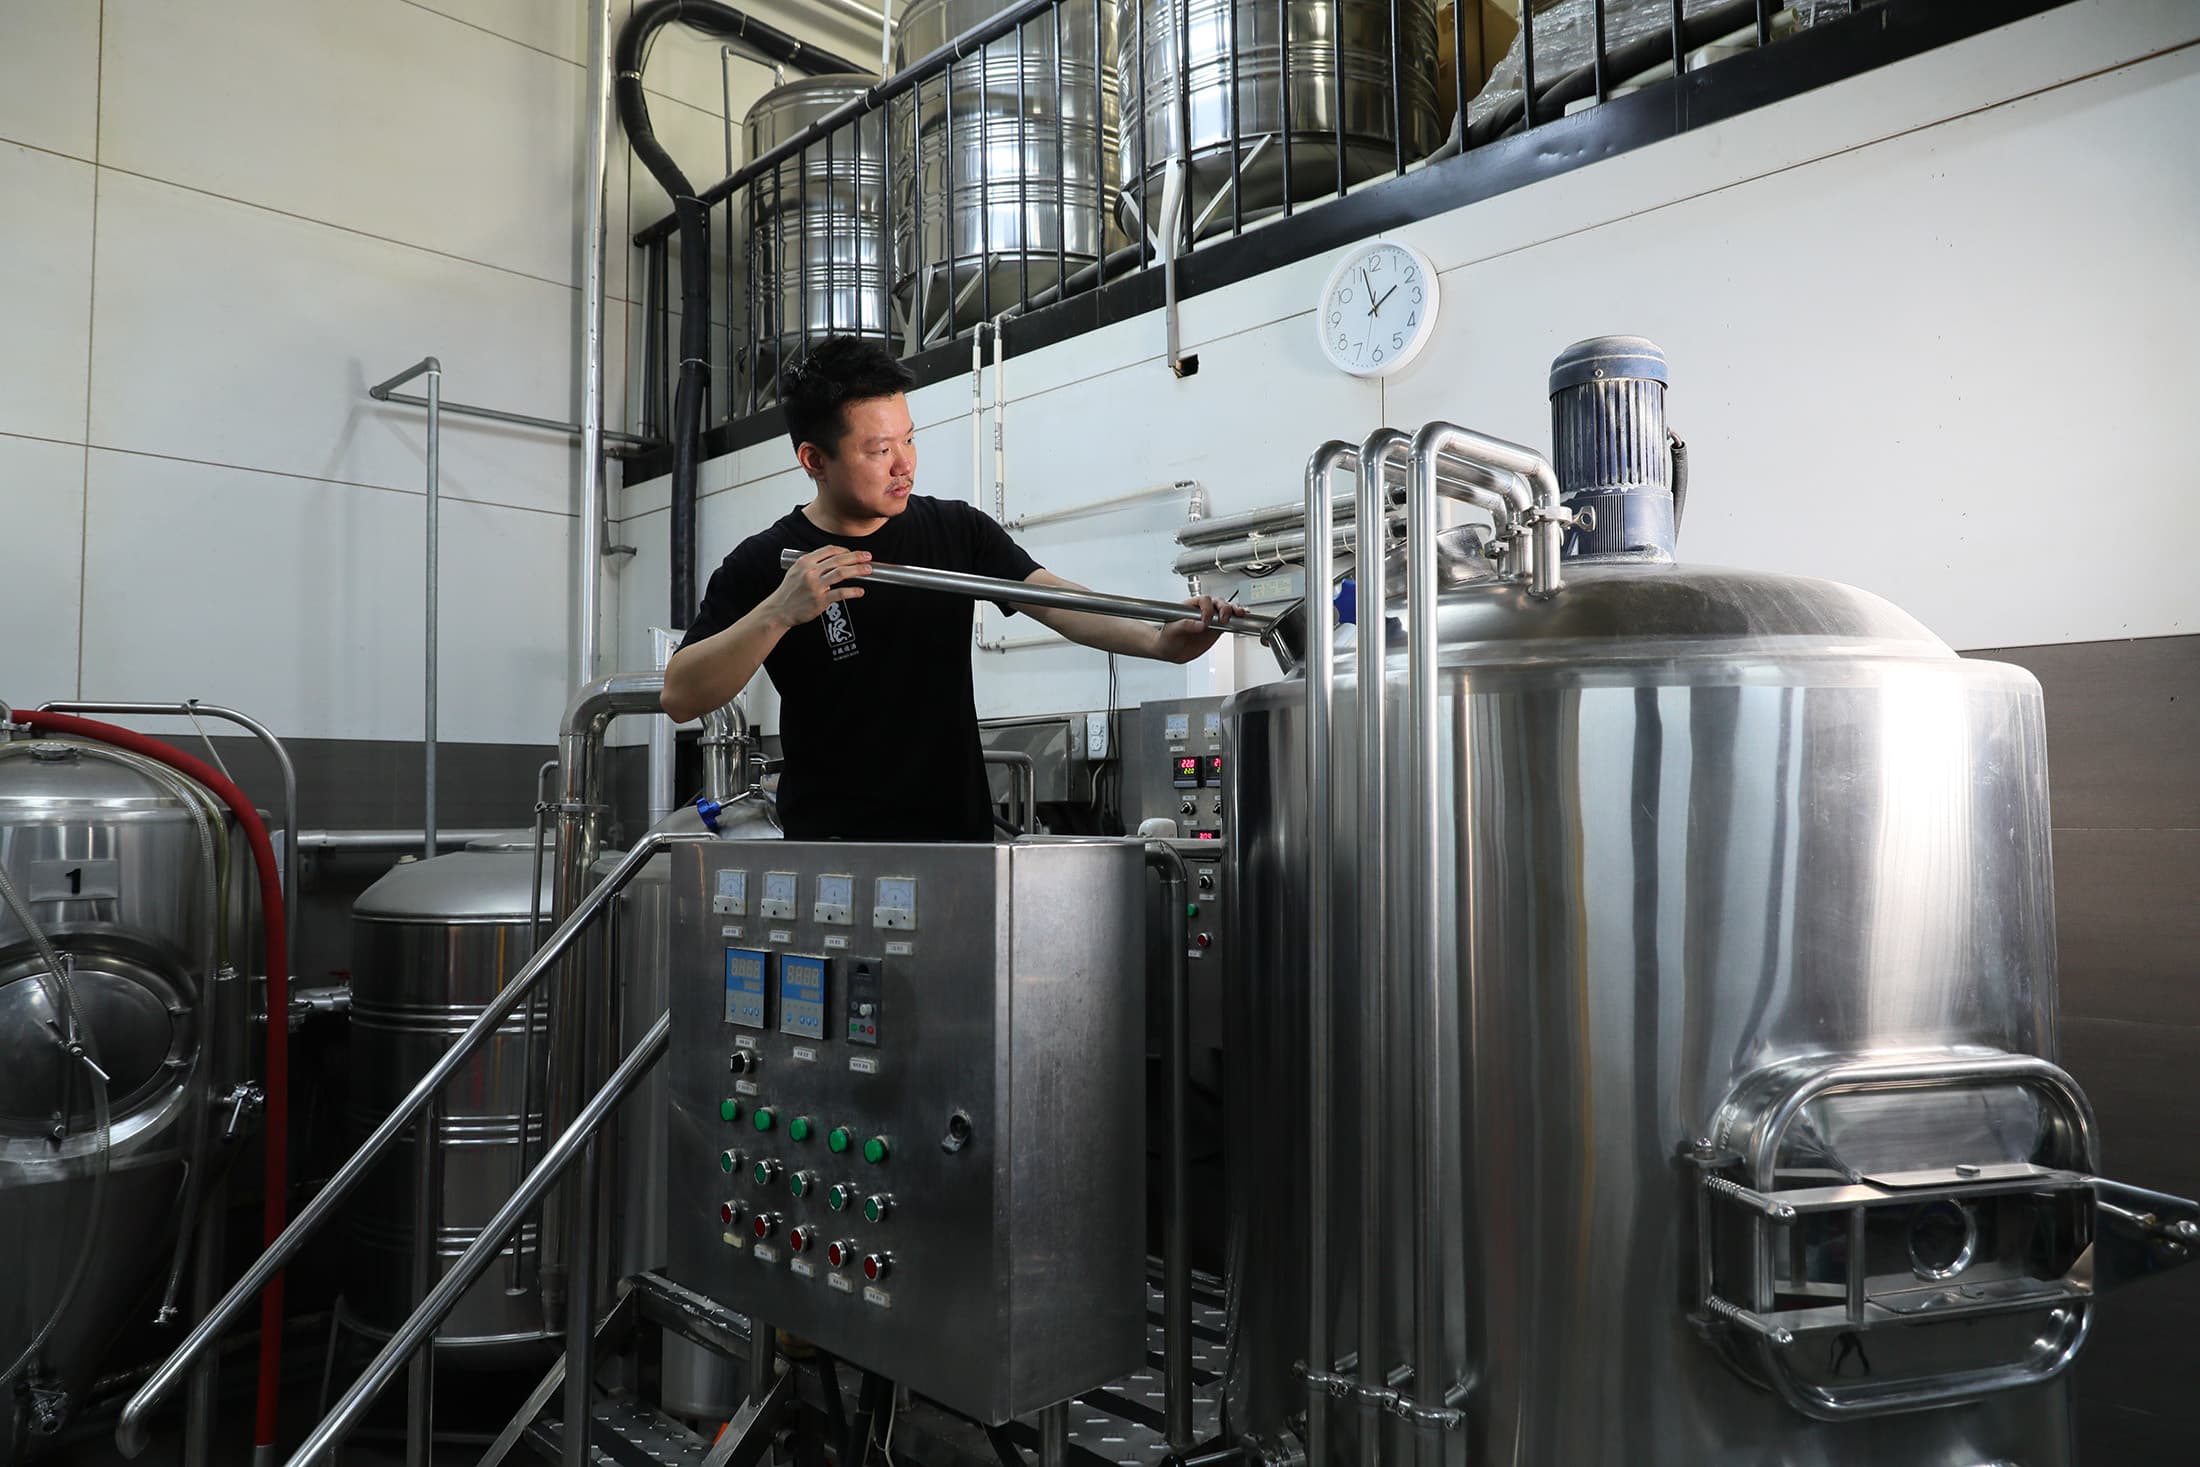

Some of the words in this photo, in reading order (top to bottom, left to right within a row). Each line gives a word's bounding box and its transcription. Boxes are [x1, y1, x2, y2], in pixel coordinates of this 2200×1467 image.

[1368, 254, 1381, 272] 12
[1352, 266, 1363, 284] 11
[1403, 265, 1415, 284] 2
[1337, 287, 1353, 306] 10
[1411, 286, 1422, 304] 3
[1331, 311, 1342, 328] 9
[1407, 311, 1416, 327] 4
[1337, 333, 1348, 350] 8
[1392, 332, 1404, 350] 5
[1353, 342, 1363, 360] 7
[1372, 344, 1384, 362] 6
[65, 867, 81, 895] 1
